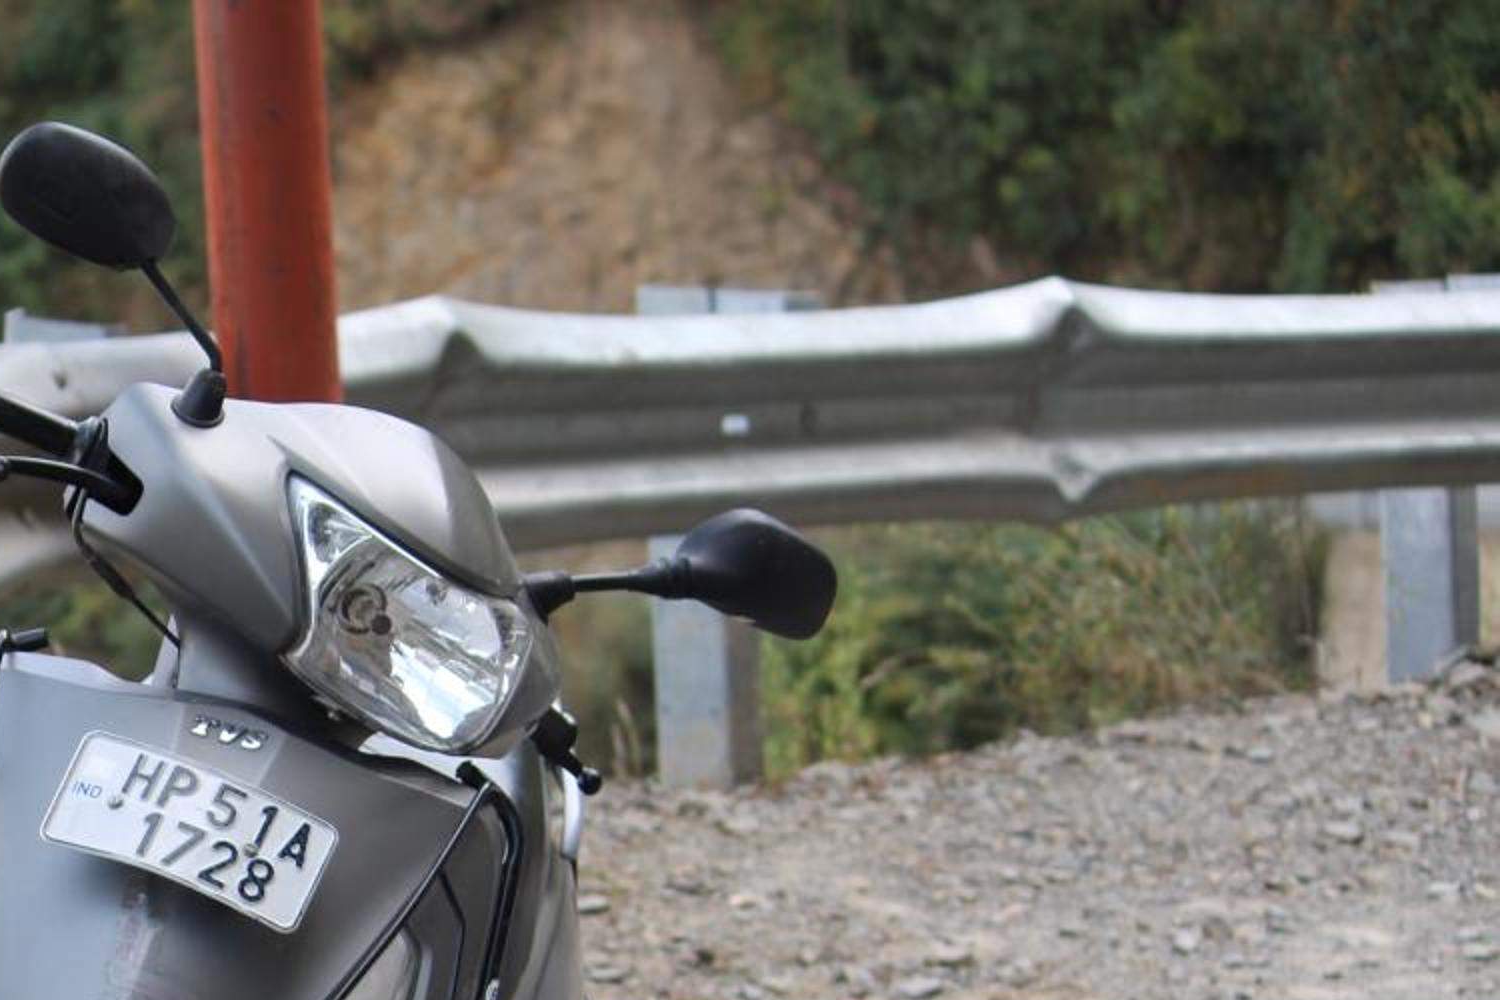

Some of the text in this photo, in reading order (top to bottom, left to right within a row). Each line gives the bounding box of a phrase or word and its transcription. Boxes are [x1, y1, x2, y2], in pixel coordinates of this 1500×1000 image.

[191, 714, 268, 749] TVS
[71, 781, 102, 799] IND
[136, 812, 275, 902] 1728
